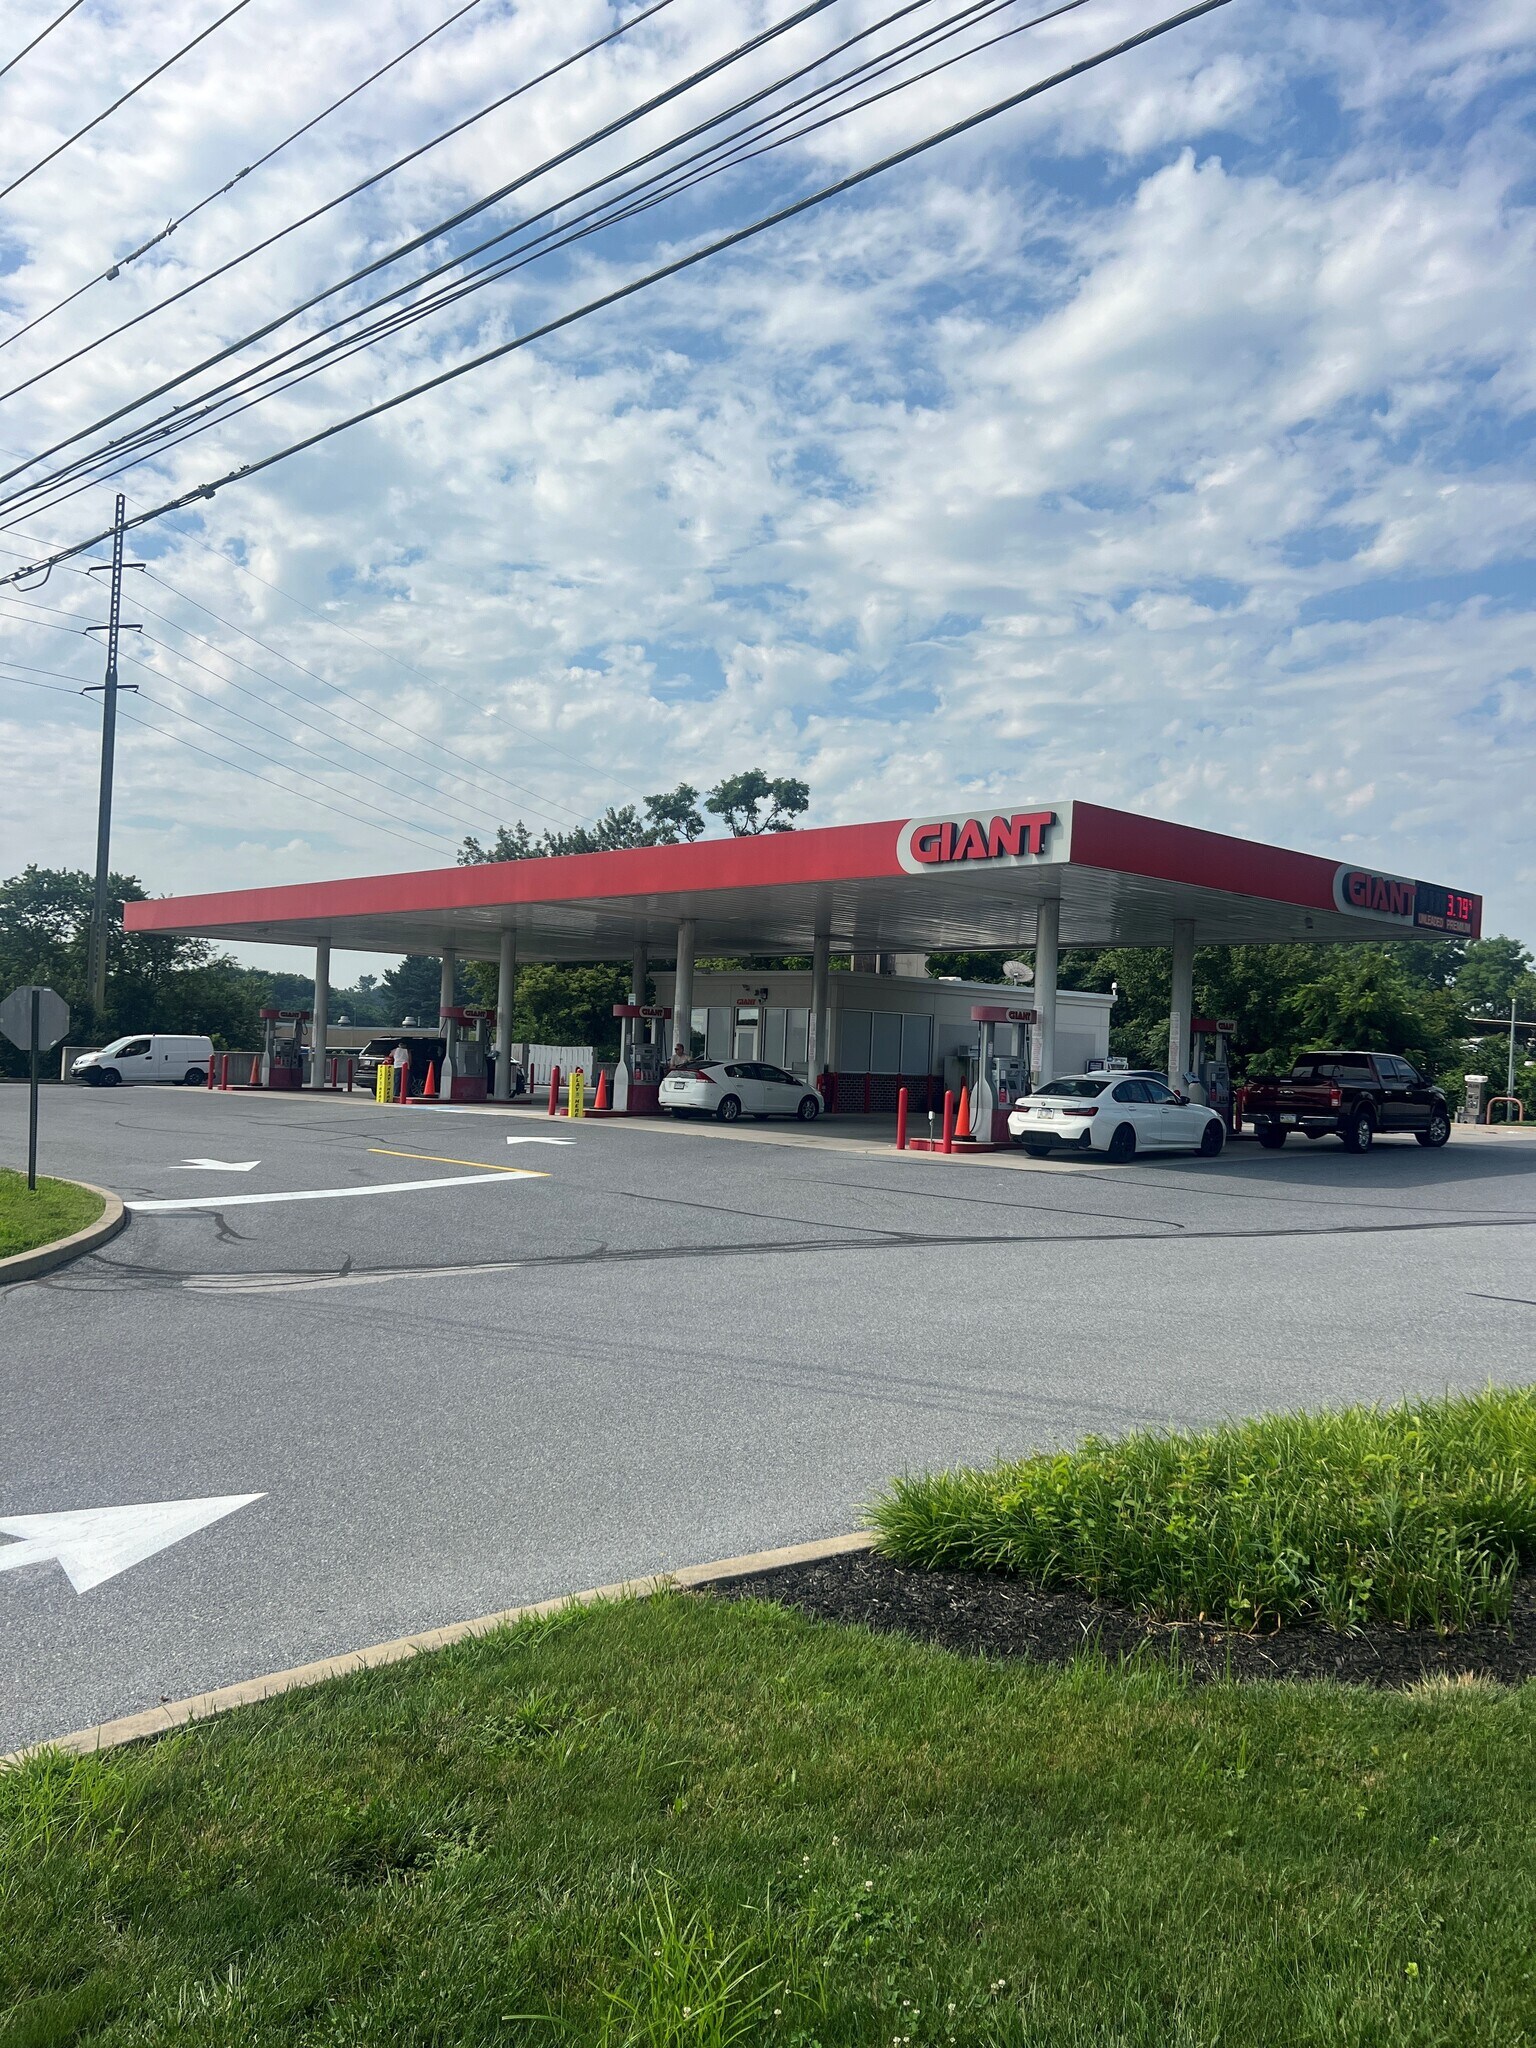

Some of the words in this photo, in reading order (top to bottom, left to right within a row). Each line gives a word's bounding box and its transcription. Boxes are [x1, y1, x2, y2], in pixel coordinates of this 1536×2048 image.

[910, 811, 1056, 863] GIANT
[1349, 871, 1416, 916] GIANT
[1418, 913, 1444, 928] UNLEADED
[1446, 919, 1471, 933] PREMIUM
[465, 1010, 486, 1018] GIANT
[641, 1008, 663, 1016] GIANT
[1008, 1010, 1031, 1020] GIANT
